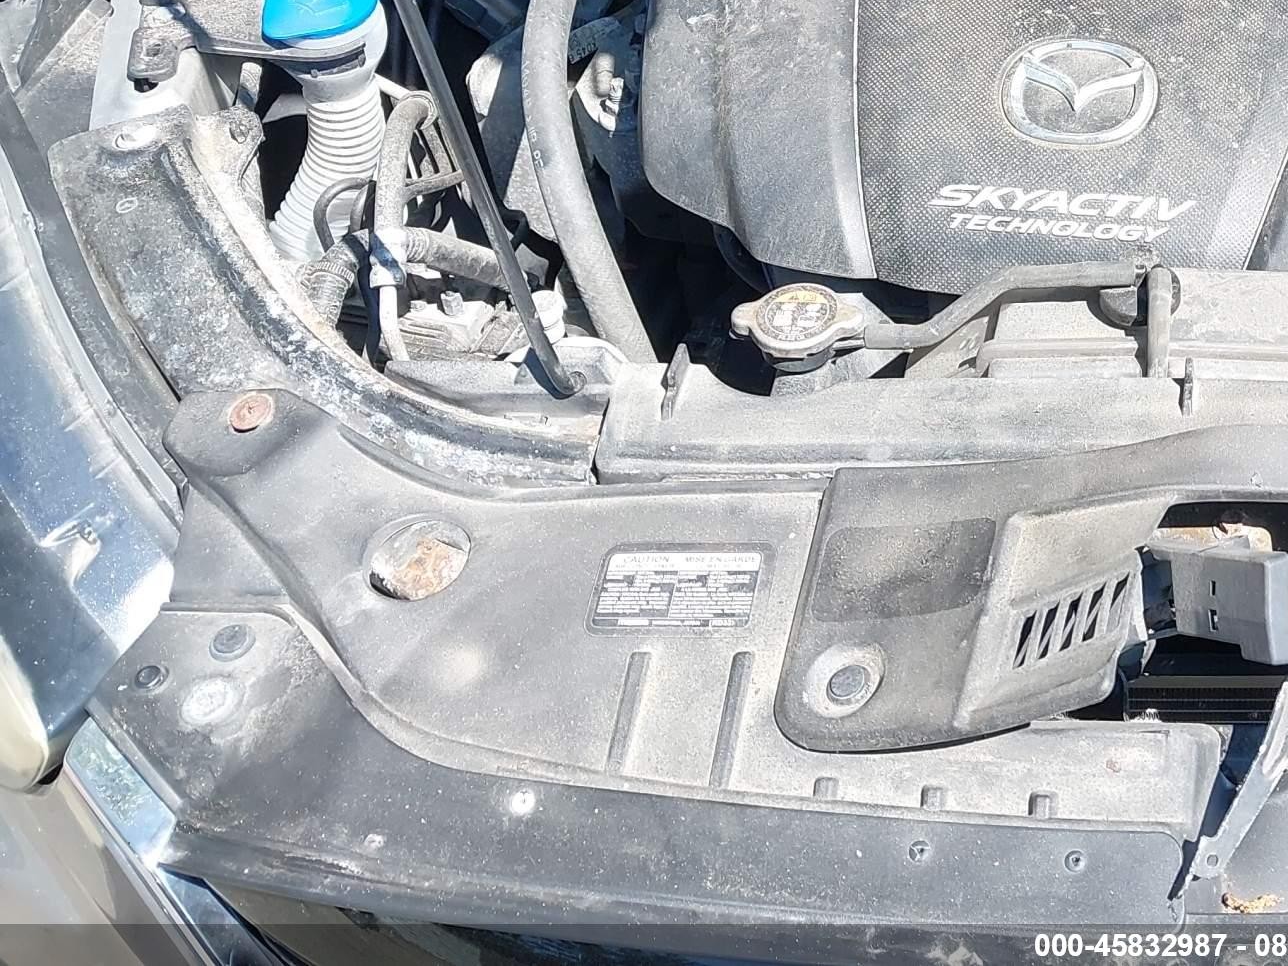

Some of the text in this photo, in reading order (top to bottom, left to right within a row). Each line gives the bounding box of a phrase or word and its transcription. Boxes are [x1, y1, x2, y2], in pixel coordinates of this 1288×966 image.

[928, 184, 1198, 222] SKYACTIV
[949, 213, 1170, 243] TECHNOLOGY
[623, 555, 670, 564] CAUTION
